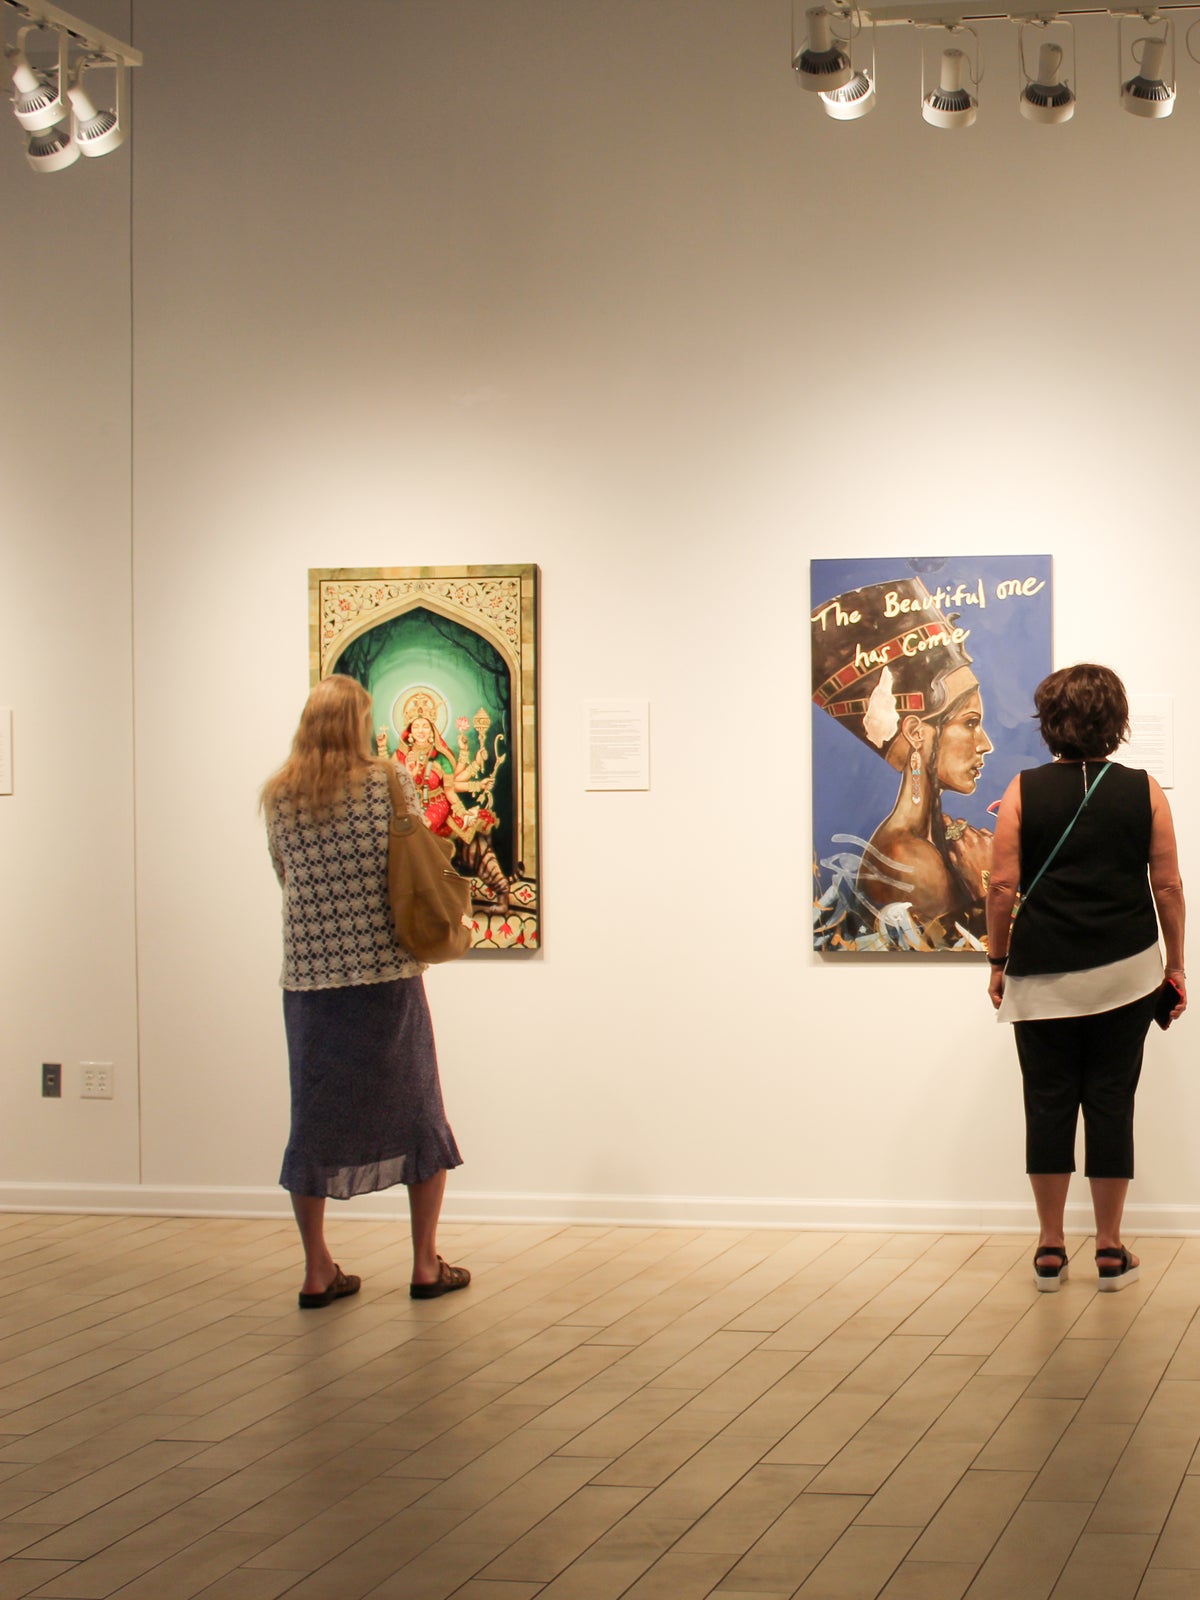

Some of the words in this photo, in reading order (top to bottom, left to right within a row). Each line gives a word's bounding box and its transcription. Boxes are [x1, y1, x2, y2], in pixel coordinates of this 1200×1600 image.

[811, 602, 862, 631] The
[883, 578, 986, 618] Beautiful
[996, 576, 1047, 600] one
[855, 643, 890, 668] has
[902, 626, 971, 657] Come
